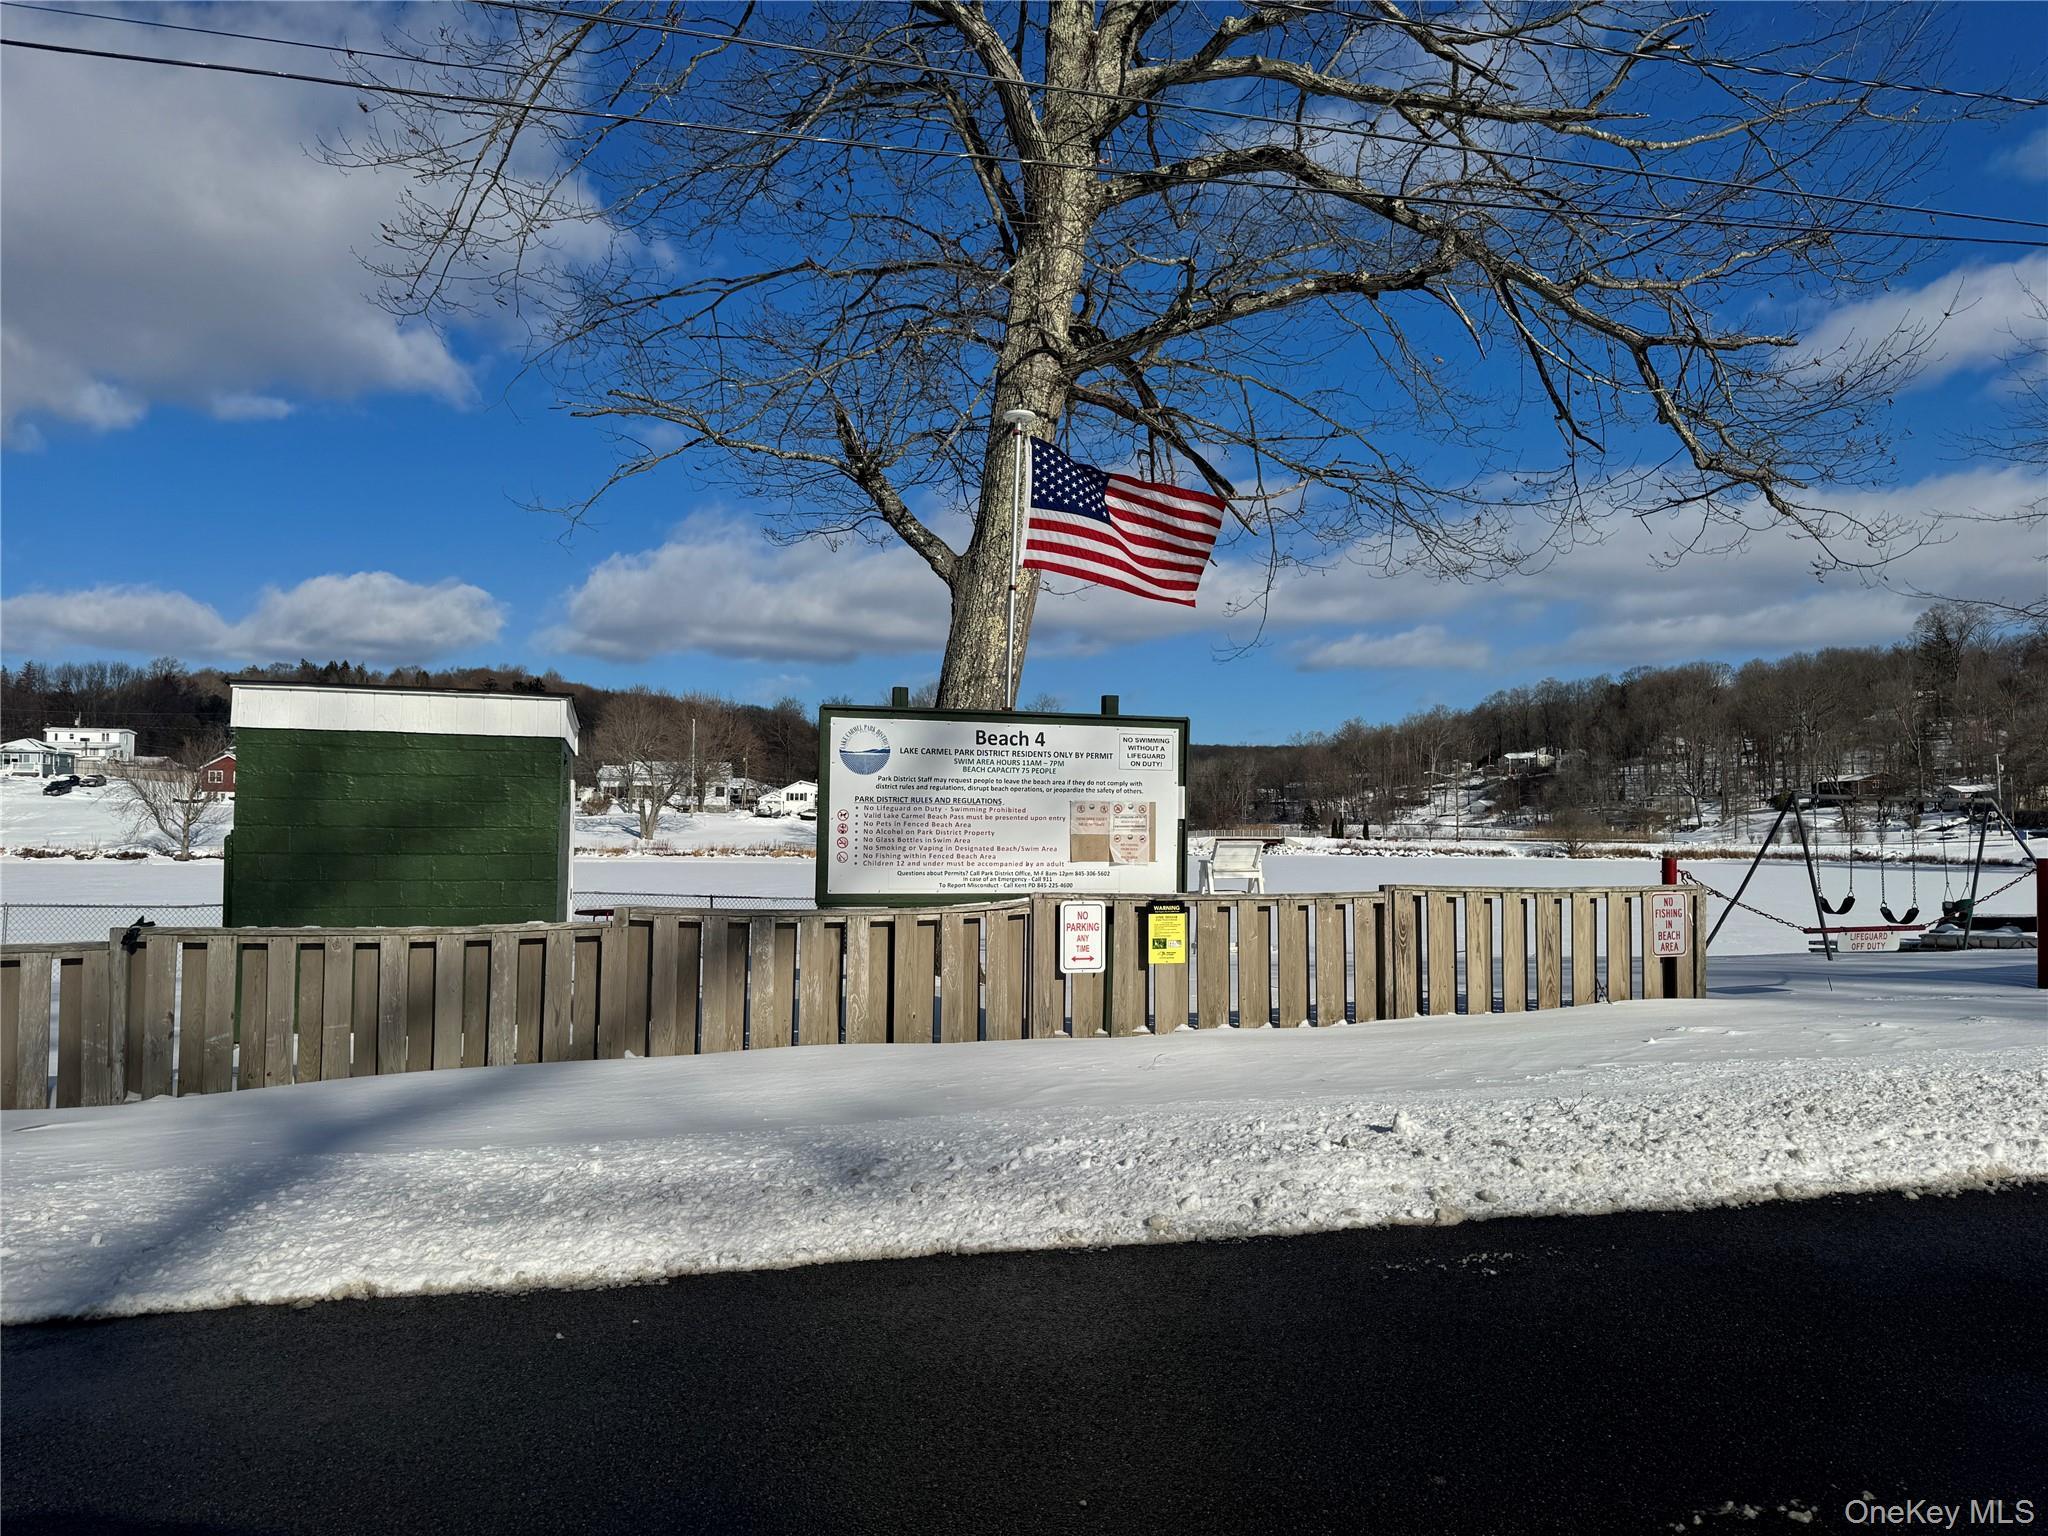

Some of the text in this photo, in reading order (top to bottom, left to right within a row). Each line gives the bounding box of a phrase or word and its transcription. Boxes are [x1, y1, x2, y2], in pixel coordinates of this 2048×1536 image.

[975, 729, 1046, 747] Beach 4
[920, 748, 951, 756] CARMEL
[976, 749, 1008, 757] DISTRICT
[1011, 750, 1051, 758] RESIDENTS
[1664, 897, 1673, 906] NO
[1077, 911, 1088, 920] NO
[1655, 909, 1682, 918] FISHING
[1066, 923, 1100, 931] PARKING
[1666, 920, 1672, 929] IN
[1658, 931, 1680, 940] BEACH
[1850, 932, 1888, 941] LIFEGUARD
[1660, 942, 1679, 951] AREA
